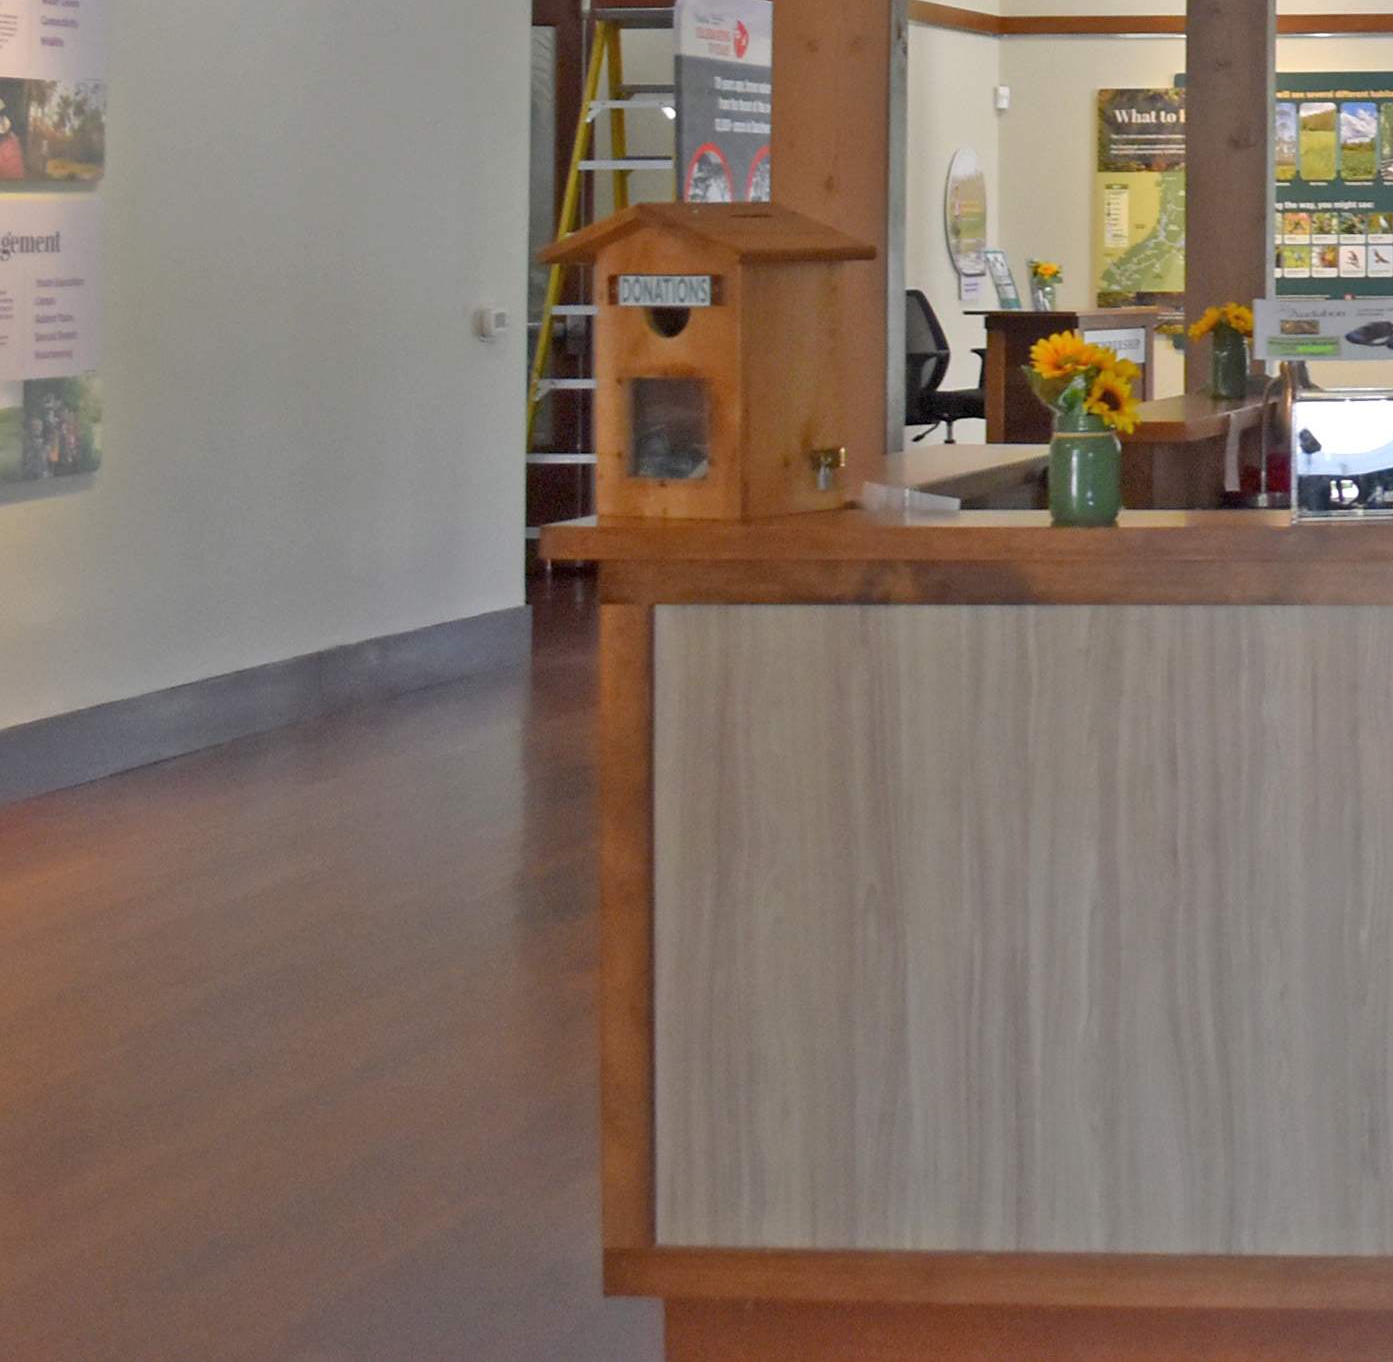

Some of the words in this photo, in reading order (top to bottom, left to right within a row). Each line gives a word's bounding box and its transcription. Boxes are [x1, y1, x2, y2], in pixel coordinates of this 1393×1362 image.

[1114, 109, 1157, 124] What
[1159, 110, 1178, 124] to
[622, 278, 707, 303] DONATIONS
